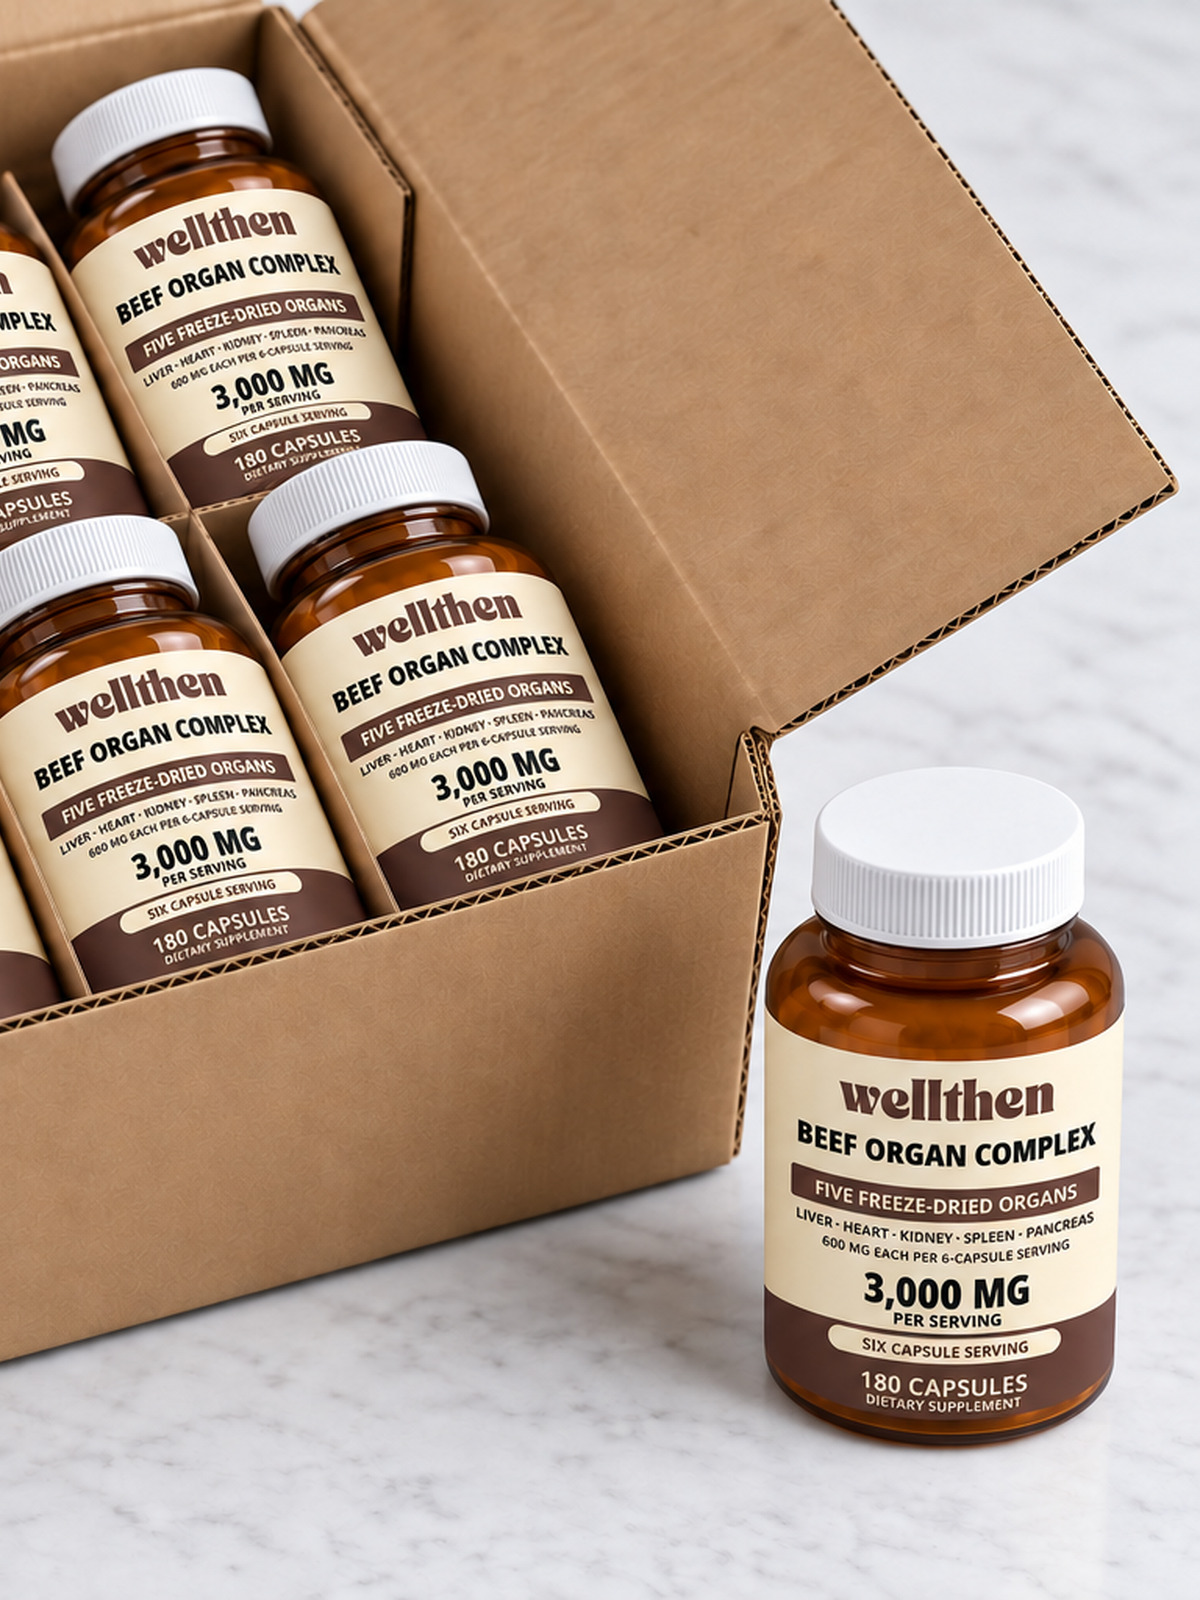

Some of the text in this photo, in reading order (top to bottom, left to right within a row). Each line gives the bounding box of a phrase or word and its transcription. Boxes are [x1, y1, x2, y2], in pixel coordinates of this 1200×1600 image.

[133, 207, 297, 269] wellthen
[116, 253, 341, 325] BEEF ORGAN COMPLEX
[143, 298, 347, 357] FIVE FREEZE-DRIED ORGANS
[211, 362, 335, 410] 3,000 MG
[0, 419, 46, 447] MG
[234, 449, 267, 470] 180
[271, 429, 361, 458] CAPSULES
[352, 592, 523, 657] wellthen
[332, 636, 569, 713] BEEF ORGAN COMPLEX
[54, 669, 227, 733] wellthen
[361, 681, 573, 746] FIVE FREEZE-DRIED ORGANS
[34, 715, 272, 791] BEEF ORGAN COMPLEX
[431, 748, 561, 801] 3,000 MG
[62, 759, 276, 824] FIVE FREEZE-DRIED ORGANS
[131, 826, 262, 880] 3,000 MG
[454, 824, 588, 871] 180 CAPSULES
[162, 857, 247, 887] PER SERVING
[153, 905, 290, 953] 180 CAPSULES
[839, 1078, 1054, 1122] wellthen
[798, 1119, 1096, 1167] BEEF ORGAN COMPLEX
[816, 1180, 1077, 1215] FIVE FREEZE-DRIED ORGANS
[796, 1207, 1094, 1244] LIVER HEART KIDNEY SPLEEN PANCREAS
[822, 1235, 846, 1250] 600
[849, 1242, 870, 1256] MG
[874, 1247, 909, 1261] EACH
[913, 1251, 937, 1263] PER
[1017, 1239, 1070, 1260] SERVING
[864, 1272, 1029, 1310] 3,000 MG
[894, 1312, 1002, 1328] PER SERVING
[862, 1337, 1028, 1358] SIX CAPSULE SERVING
[862, 1371, 1027, 1397] 180 CAPSULES
[866, 1393, 1021, 1413] DIETARY SUPPLEMENT
